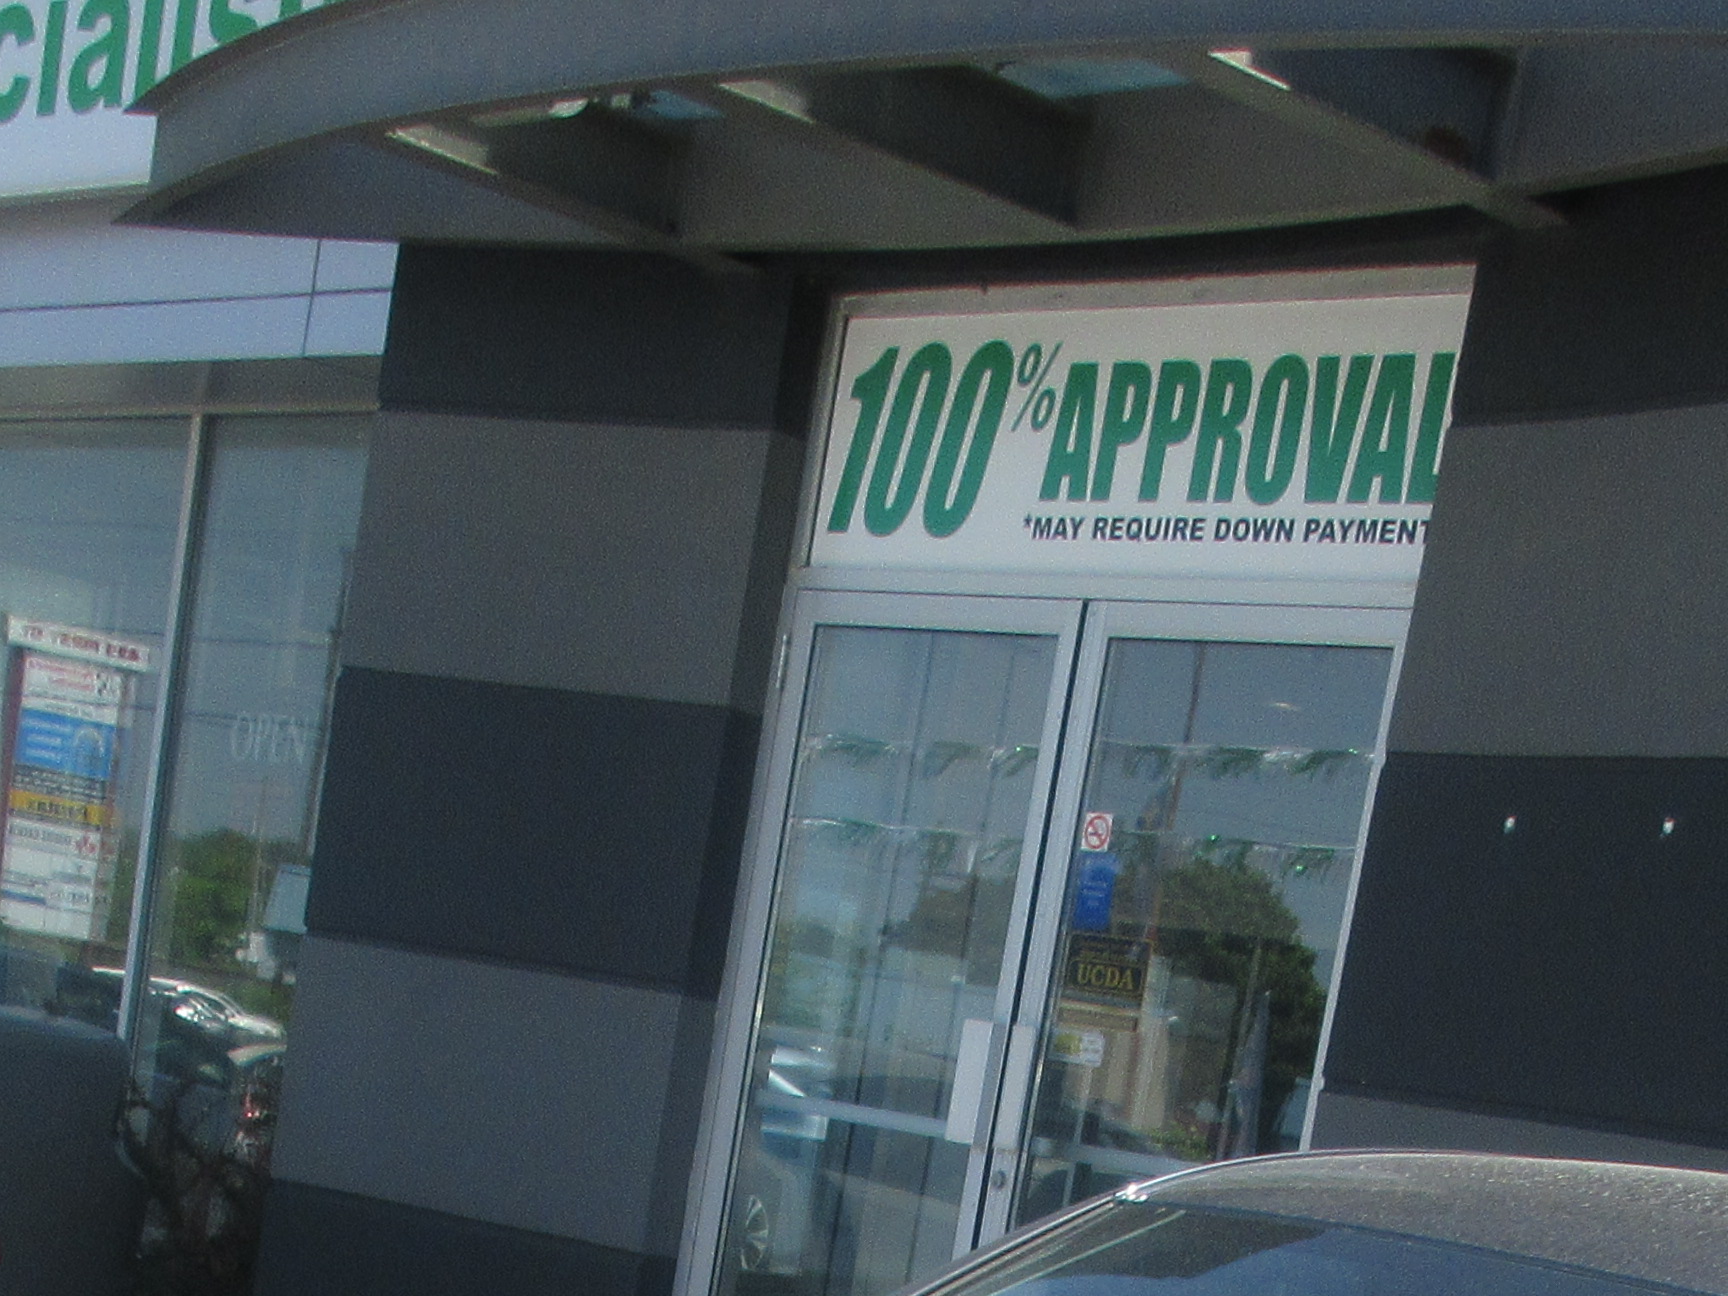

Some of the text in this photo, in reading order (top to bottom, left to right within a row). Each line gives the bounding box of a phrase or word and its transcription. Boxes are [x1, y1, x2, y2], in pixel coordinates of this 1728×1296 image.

[827, 340, 1458, 537] 100% APPROVAL
[1092, 515, 1205, 543] REQUIRE
[1213, 516, 1296, 543] DOWN
[1076, 962, 1134, 990] UCDA
